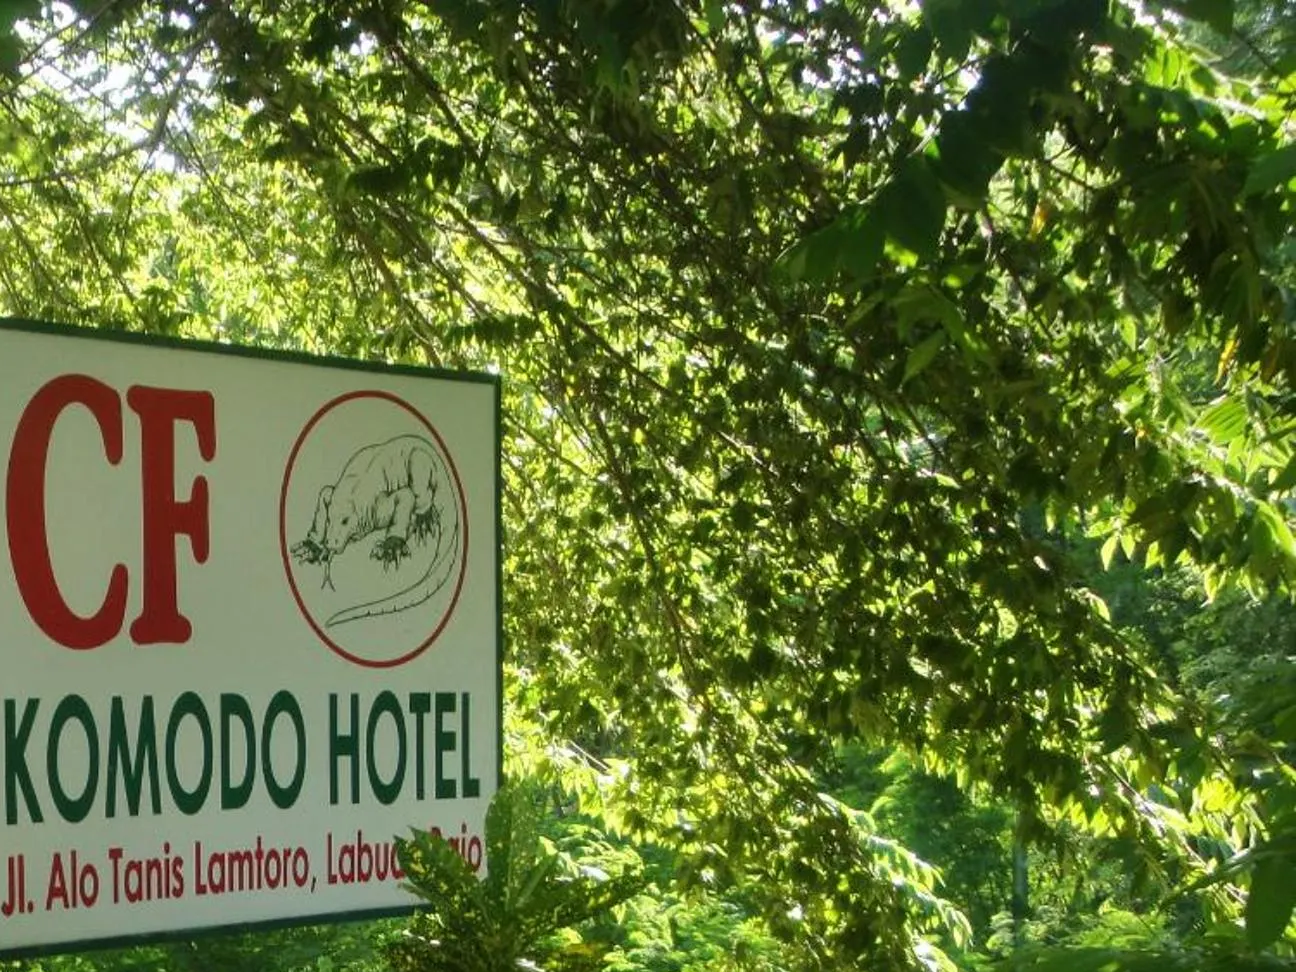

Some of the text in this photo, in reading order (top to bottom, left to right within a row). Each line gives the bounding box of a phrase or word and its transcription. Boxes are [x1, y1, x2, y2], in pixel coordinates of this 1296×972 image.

[5, 373, 216, 650] CF
[4, 689, 481, 826] KOMODO HOTEL
[1, 853, 34, 917] Jl.
[45, 849, 100, 909] Alo
[108, 841, 184, 904] Tanis
[194, 835, 317, 895] Lamtoro,
